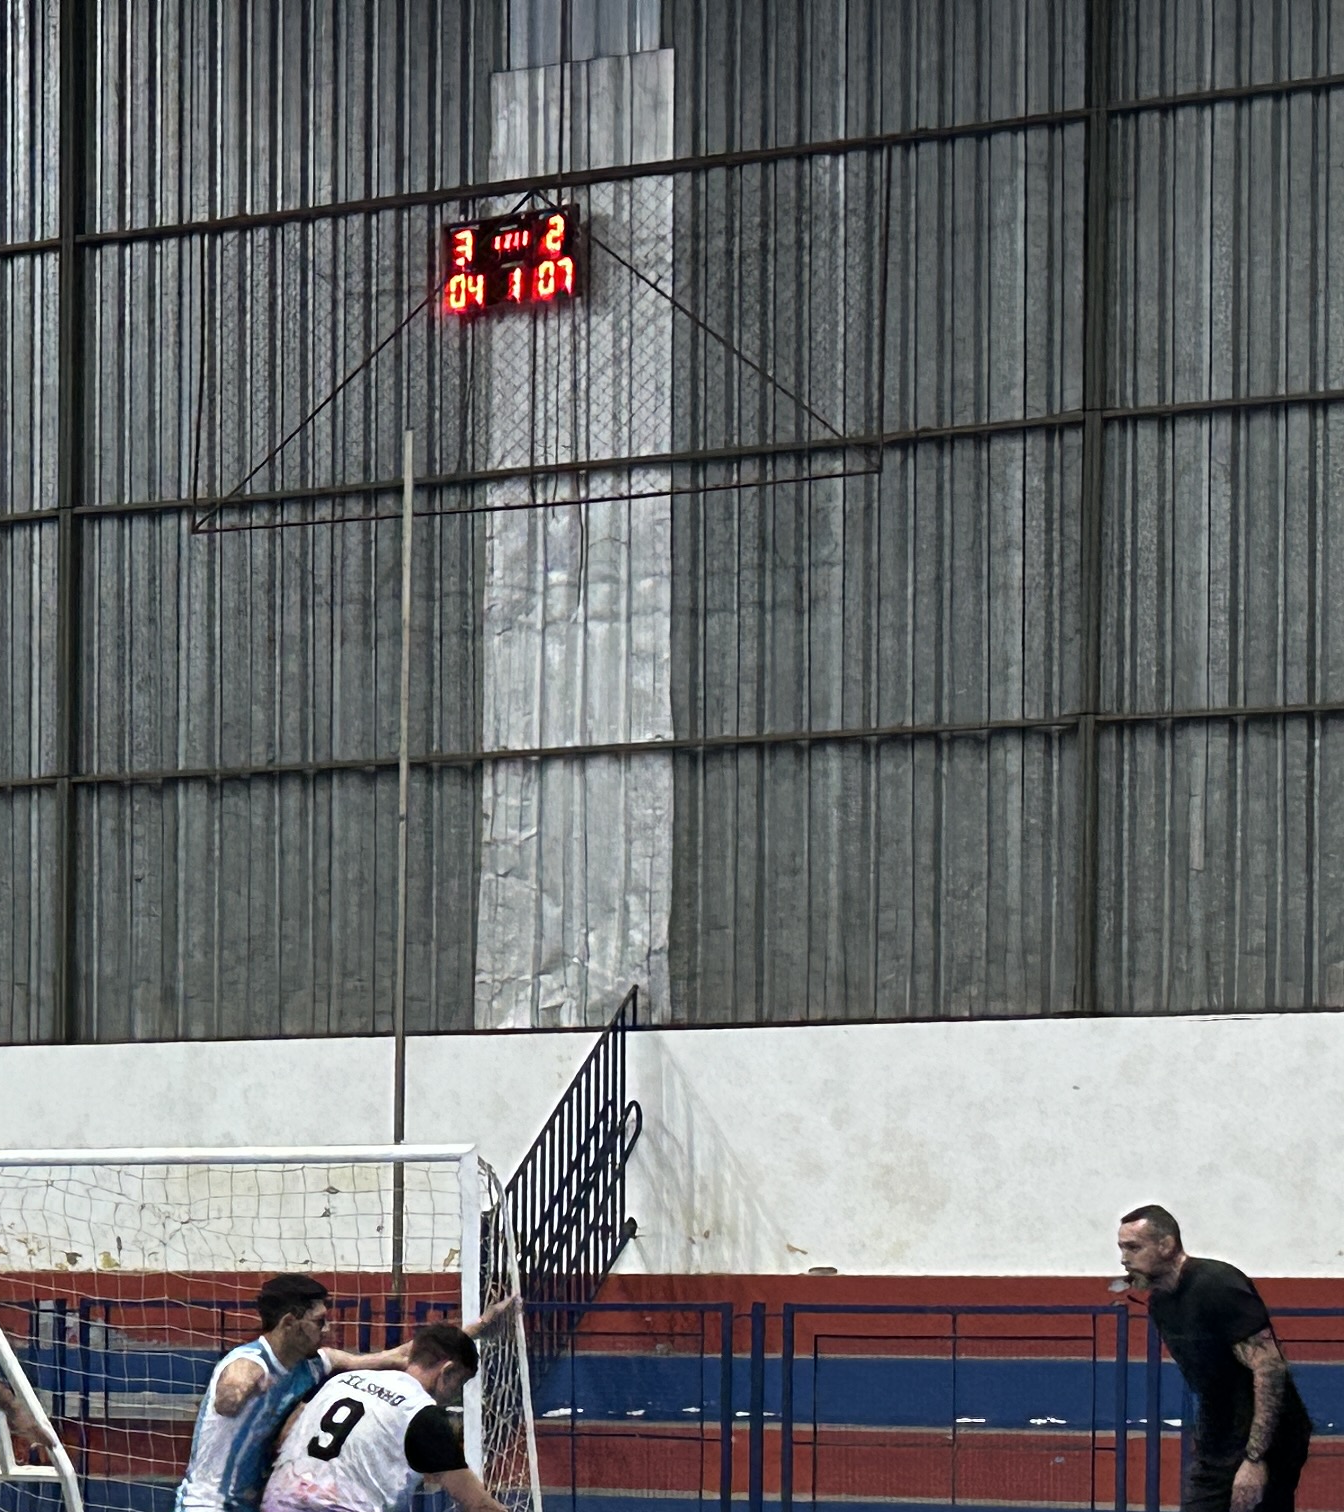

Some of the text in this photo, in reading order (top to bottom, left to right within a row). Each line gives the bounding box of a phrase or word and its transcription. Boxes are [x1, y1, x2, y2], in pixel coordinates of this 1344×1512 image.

[546, 214, 564, 251] 2
[449, 273, 484, 309] 04
[538, 257, 573, 296] 07
[307, 1397, 365, 1461] 9
